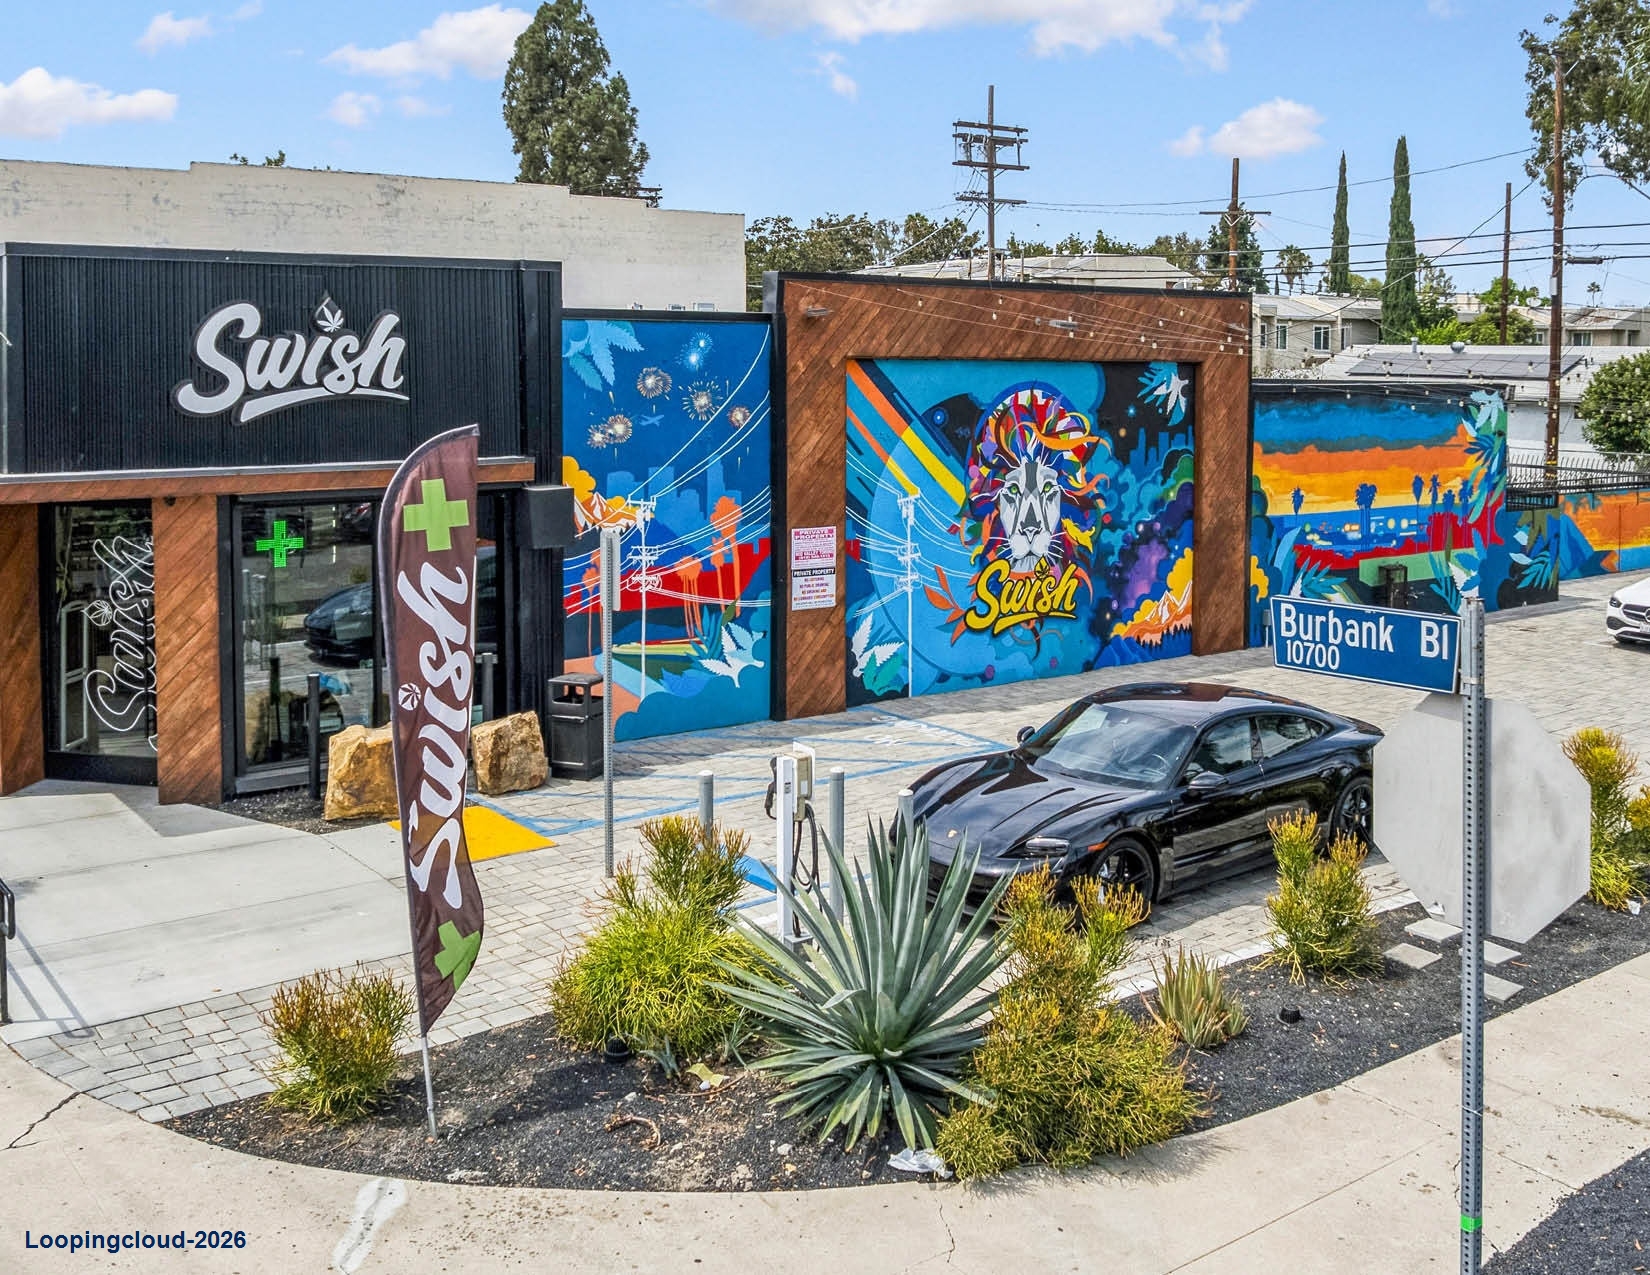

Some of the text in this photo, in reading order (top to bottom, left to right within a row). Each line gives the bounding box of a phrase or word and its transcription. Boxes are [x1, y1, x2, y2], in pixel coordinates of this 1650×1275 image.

[176, 292, 410, 423] Swish
[964, 557, 1079, 635] Swish
[1280, 602, 1449, 660] Burbank Bl
[1286, 640, 1340, 671] 10700
[398, 561, 471, 910] Swish
